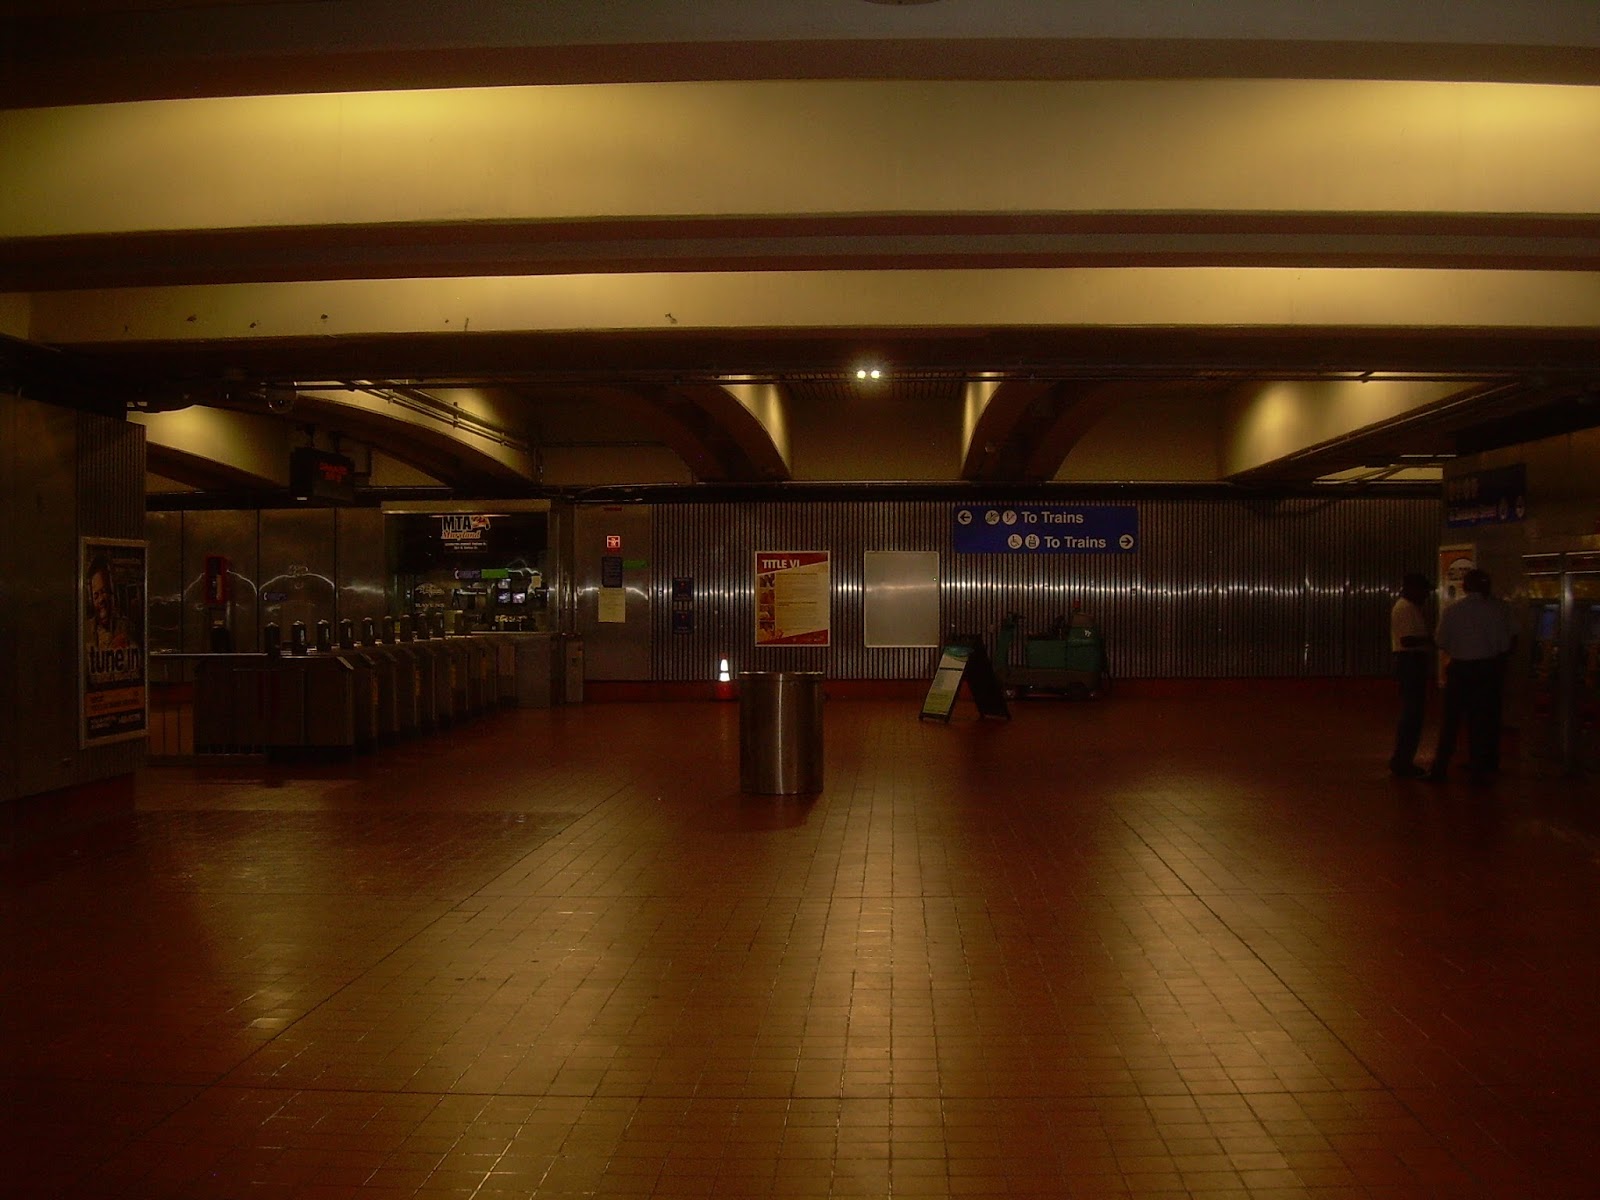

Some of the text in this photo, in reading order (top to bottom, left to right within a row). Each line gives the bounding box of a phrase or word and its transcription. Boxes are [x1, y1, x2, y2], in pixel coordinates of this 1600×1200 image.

[1021, 511, 1084, 523] To Trains
[442, 516, 472, 531] MTA
[441, 530, 481, 541] Maryland
[1044, 536, 1106, 548] To Trains
[762, 559, 800, 569] TITLE VI
[90, 646, 139, 673] tune in
